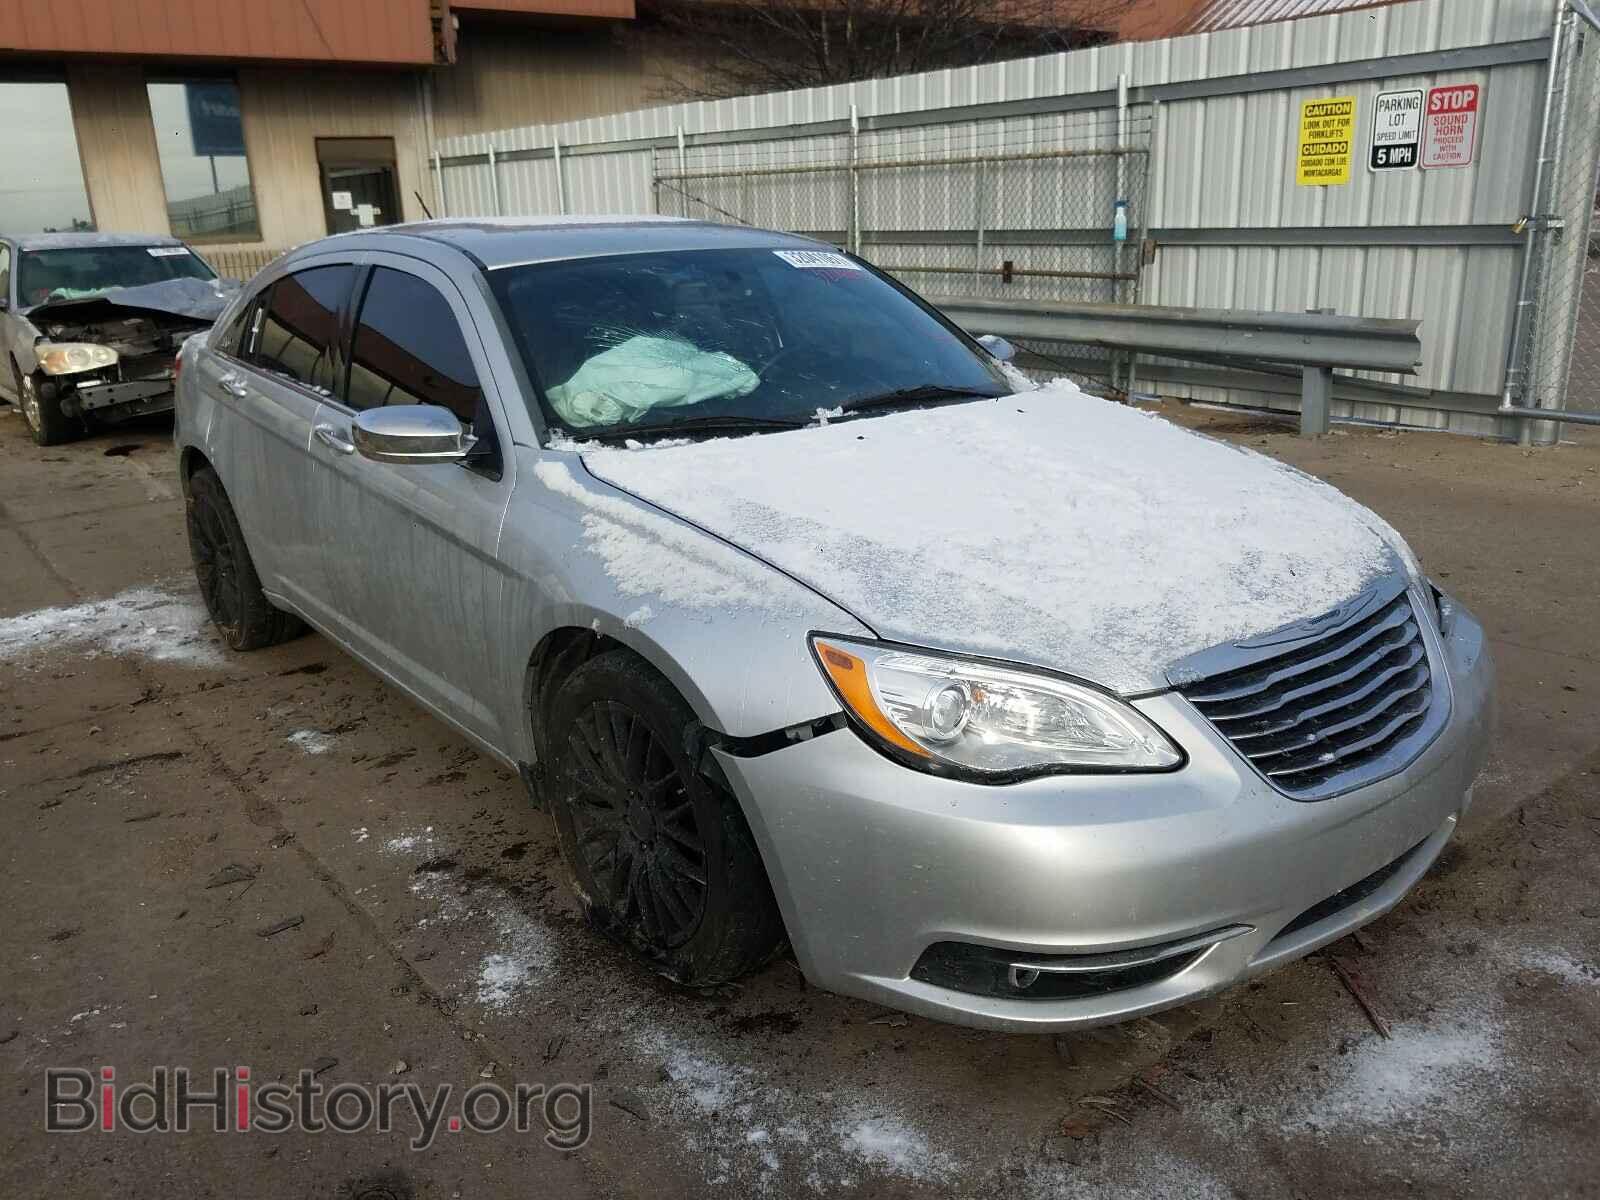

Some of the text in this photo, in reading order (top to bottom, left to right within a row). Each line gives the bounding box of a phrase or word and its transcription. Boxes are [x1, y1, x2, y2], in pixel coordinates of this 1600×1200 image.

[1379, 97, 1419, 112] PARKING
[1431, 90, 1475, 110] STOP
[1306, 103, 1351, 117] CAUTION
[1304, 118, 1350, 130] LOOK OUT FOR
[1389, 113, 1406, 126] LOT
[1434, 114, 1468, 126] SOUND
[1309, 129, 1344, 139] FORKLIFTS
[1377, 130, 1416, 141] SPEED LIMIT
[1436, 125, 1464, 136] HORN
[1434, 136, 1464, 144] PROCEED
[1303, 142, 1347, 156] CUIDADO
[1440, 144, 1457, 152] WITH
[1377, 147, 1412, 164] 5 MPH
[1433, 152, 1462, 161] CAUTION
[1324, 158, 1335, 167] CON
[1303, 168, 1342, 178] MONTACARGAS
